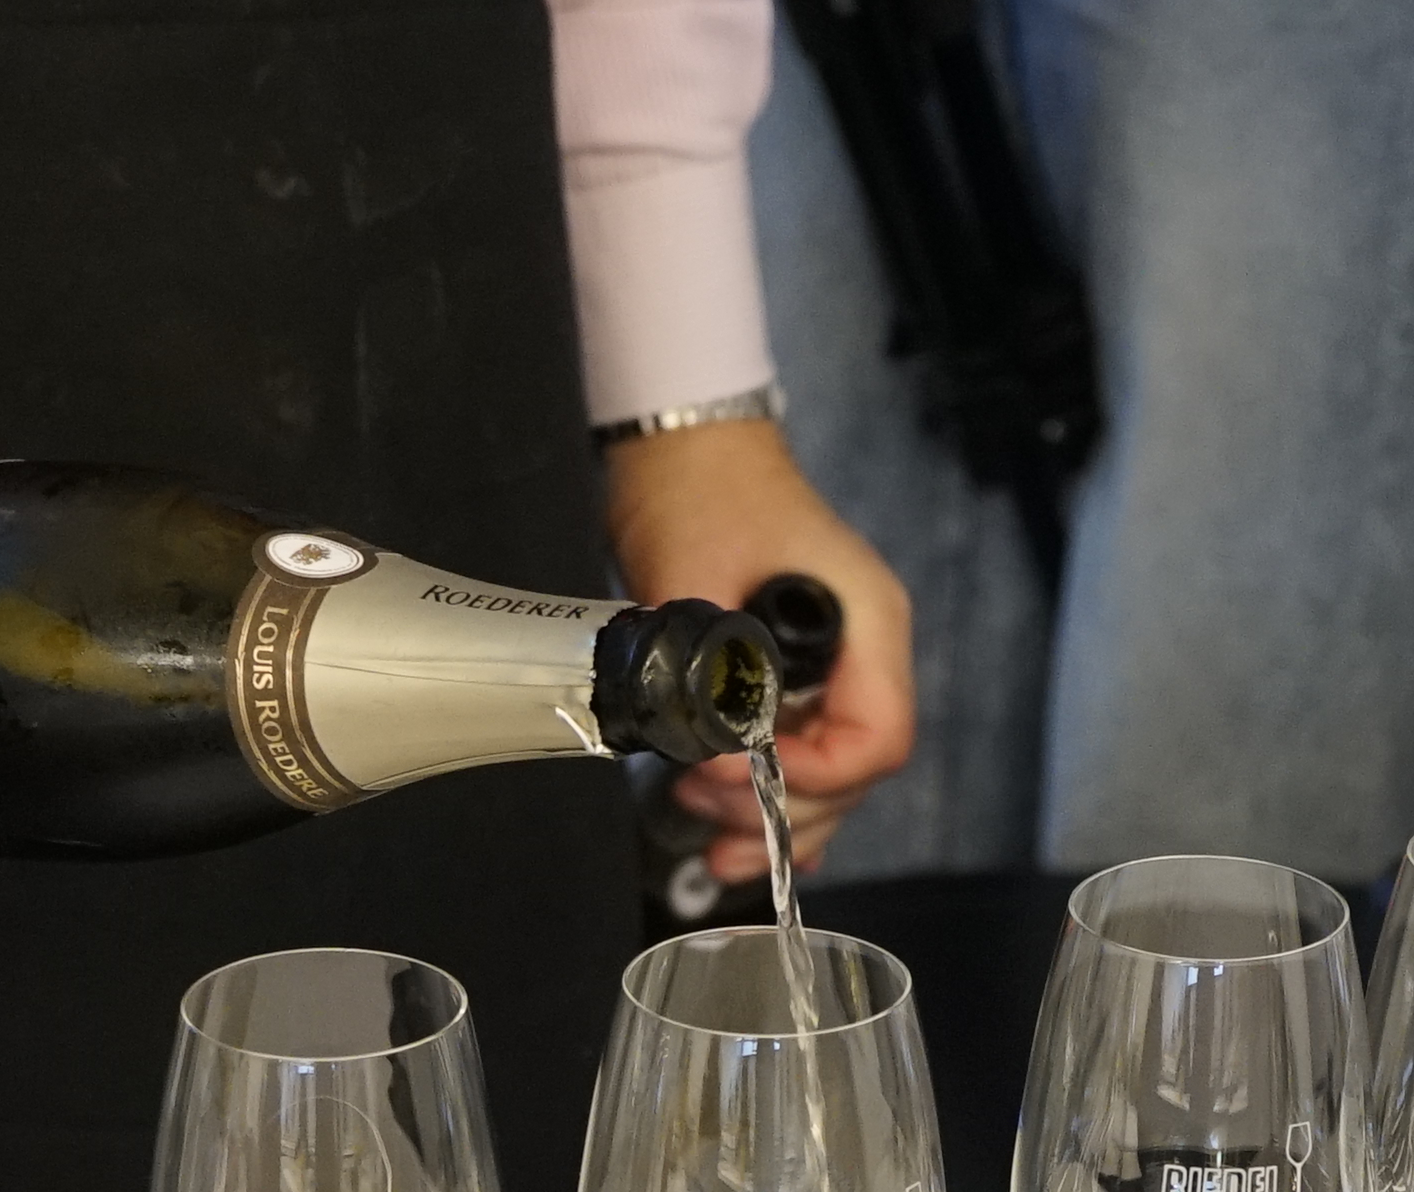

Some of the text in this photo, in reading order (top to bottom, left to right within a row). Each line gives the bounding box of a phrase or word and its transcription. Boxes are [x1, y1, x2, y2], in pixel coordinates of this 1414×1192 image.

[419, 582, 590, 621] ROEDERER
[252, 606, 329, 799] LOUIS ROEDERE
